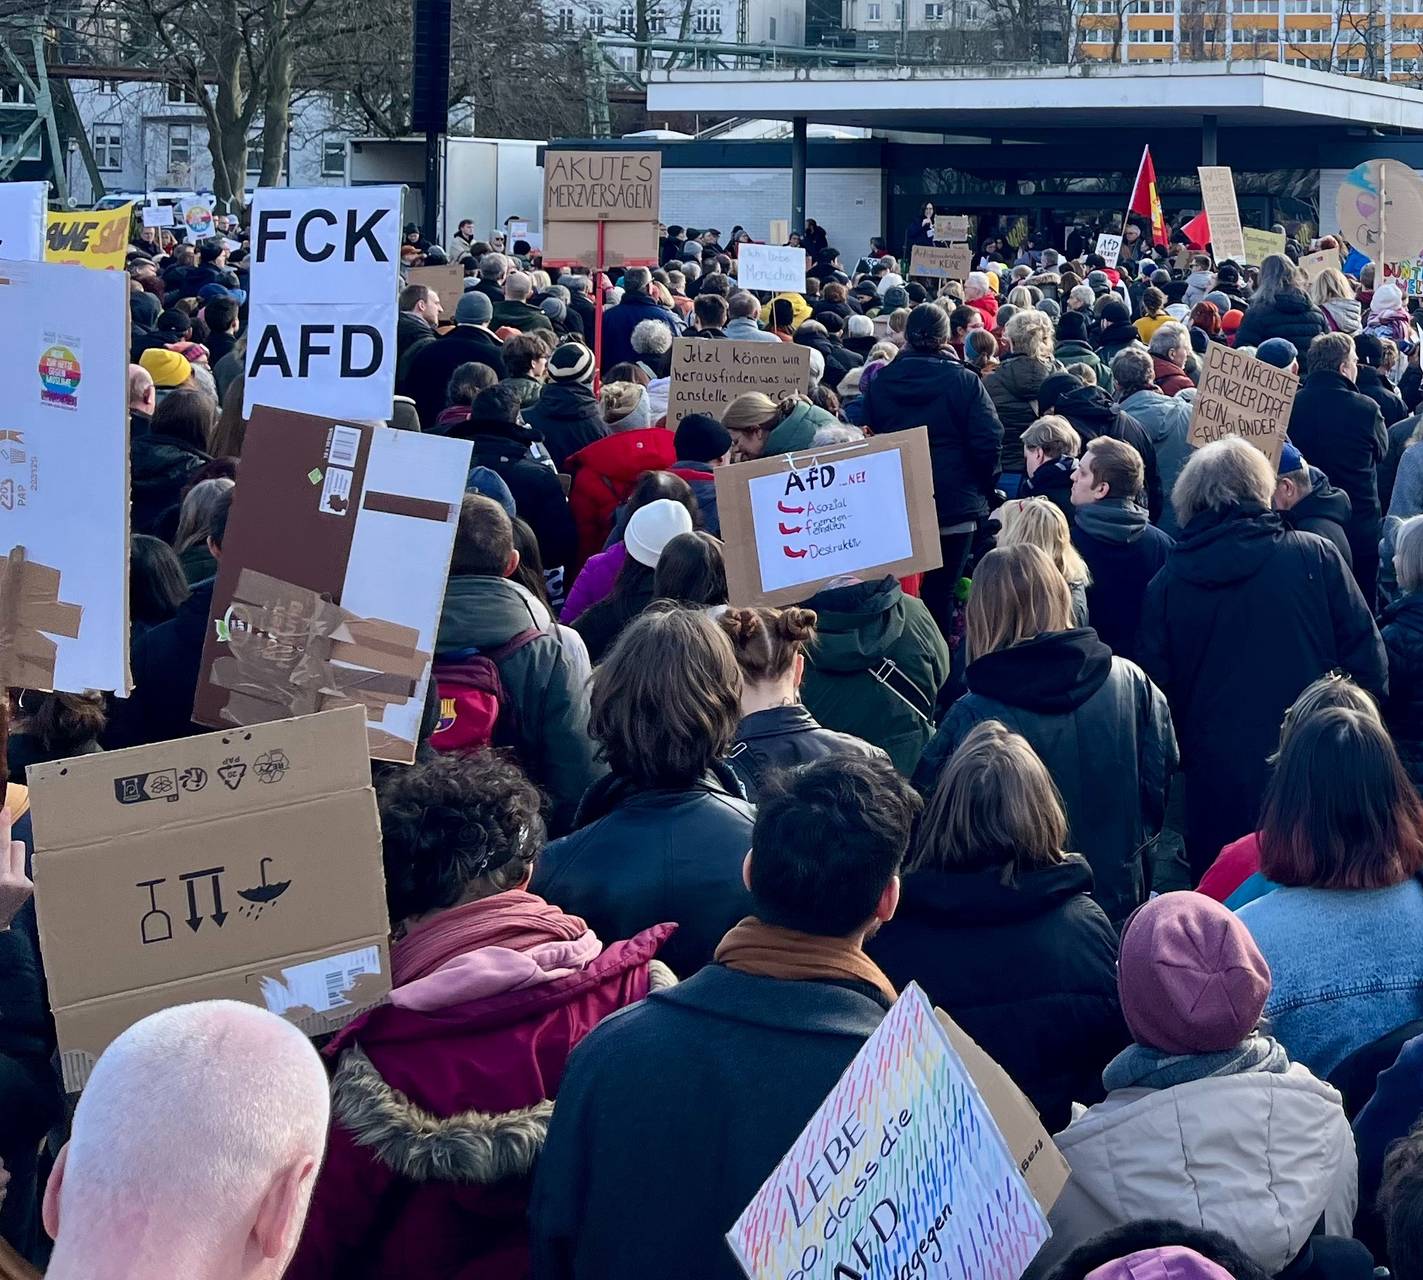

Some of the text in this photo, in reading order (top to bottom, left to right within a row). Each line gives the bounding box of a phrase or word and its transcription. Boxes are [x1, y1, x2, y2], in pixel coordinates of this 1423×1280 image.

[550, 155, 653, 182] AKUTES
[549, 184, 653, 209] MERZVERSAGEN
[255, 208, 391, 262] FCK
[1100, 239, 1119, 251] AfD
[745, 264, 797, 281] Menschen
[939, 259, 961, 271] KEINE
[247, 324, 384, 378] AFD
[732, 347, 777, 365] können
[782, 354, 800, 366] wir
[673, 367, 801, 385] herausfinden was wir
[1209, 347, 1299, 398] DER NÄCHSTE
[676, 387, 729, 403] anstelle
[1204, 371, 1292, 419] KANZLER DARF
[1198, 395, 1229, 424] KEIN
[784, 465, 836, 496] AfD
[17, 484, 27, 506] PAP
[806, 498, 848, 516] Asozial
[808, 537, 862, 559] Destruktiv
[222, 755, 241, 765] PAP
[784, 1109, 868, 1229] LEBE
[822, 1159, 880, 1241] dass
[880, 1107, 914, 1158] die
[893, 1203, 954, 1280] agegen
